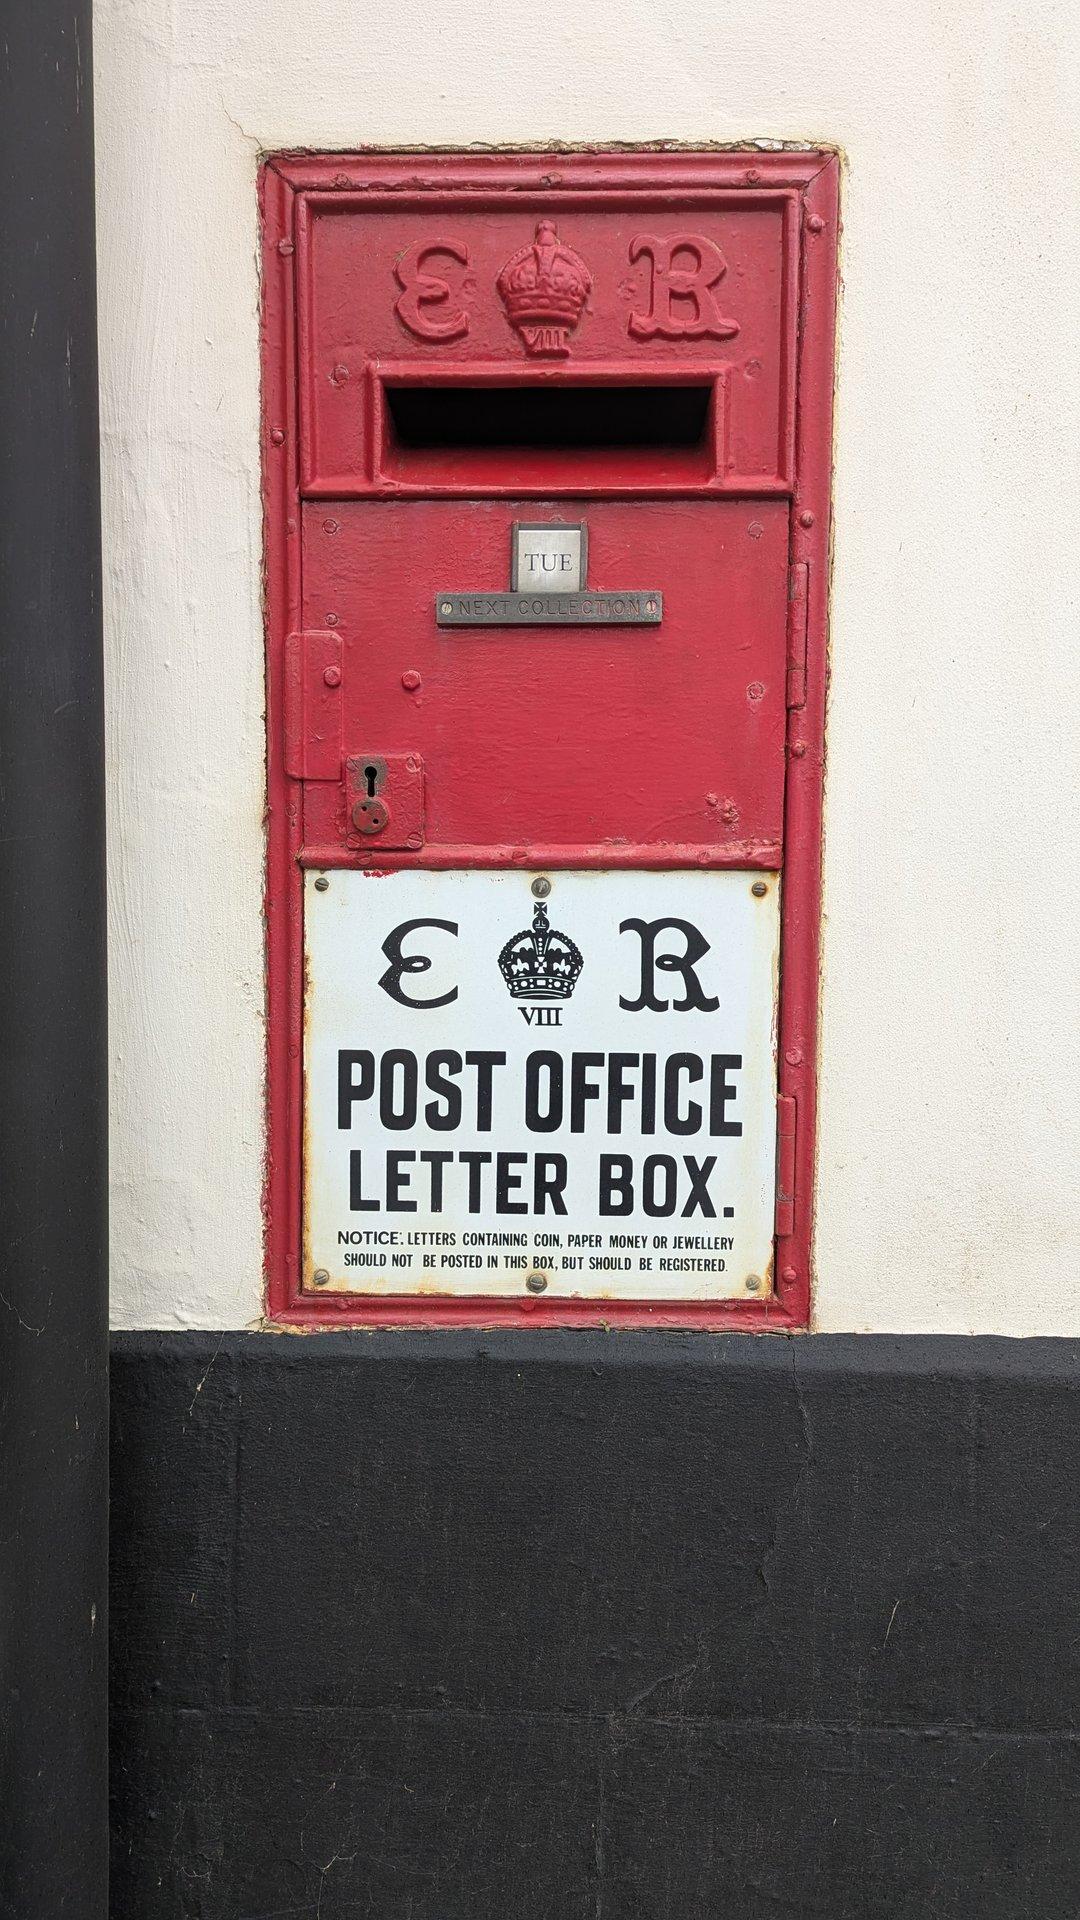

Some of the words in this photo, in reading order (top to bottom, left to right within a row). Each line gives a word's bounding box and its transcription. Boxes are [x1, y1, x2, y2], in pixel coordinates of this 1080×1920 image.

[394, 238, 469, 343] E
[629, 234, 739, 341] R
[519, 326, 570, 352] VIII
[524, 553, 573, 572] TUE
[459, 600, 510, 616] NEXT
[518, 600, 640, 617] COLLECTION
[378, 918, 459, 1010] E
[619, 918, 721, 1013] R
[518, 1007, 564, 1027] VIII
[338, 1049, 507, 1132] POST
[526, 1050, 743, 1137] OFFICE
[350, 1150, 569, 1216] LETTER
[599, 1154, 735, 1219] BOX.
[407, 1232, 457, 1246] LETTERS
[462, 1232, 528, 1247] CONTAINING
[533, 1233, 563, 1249] COIN,
[567, 1234, 603, 1248] PAPER
[609, 1235, 648, 1249] MONEY
[652, 1236, 668, 1249] OR
[672, 1236, 735, 1250] JEWELLERY
[343, 1253, 387, 1267] SHOULD
[391, 1254, 414, 1267] NOT
[422, 1254, 437, 1268] BE
[440, 1255, 483, 1269] POSTED
[487, 1256, 498, 1269] IN
[503, 1256, 528, 1269] THIS
[532, 1256, 559, 1272] BOX,
[561, 1256, 585, 1270] BUT
[588, 1257, 632, 1271] SHOULD
[639, 1258, 653, 1271] BE
[659, 1258, 728, 1272] REGISTERED.
